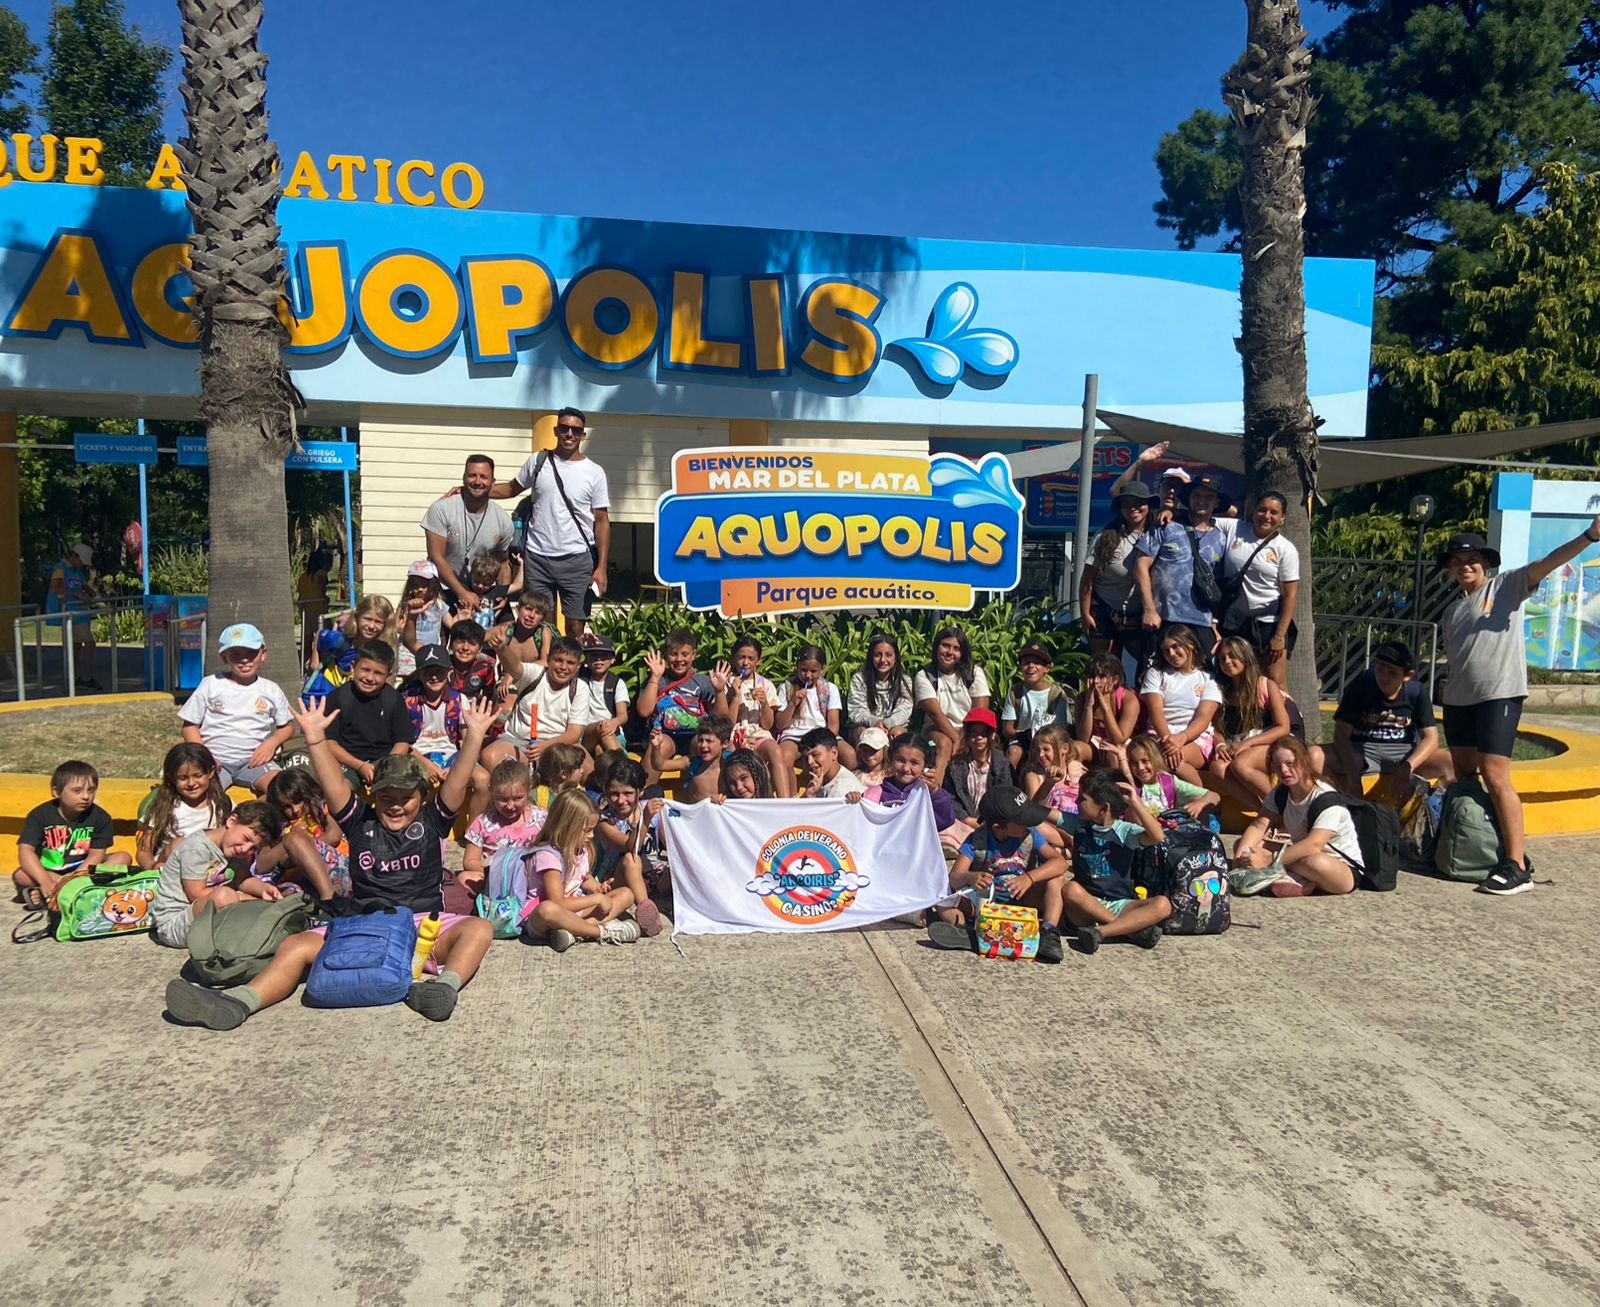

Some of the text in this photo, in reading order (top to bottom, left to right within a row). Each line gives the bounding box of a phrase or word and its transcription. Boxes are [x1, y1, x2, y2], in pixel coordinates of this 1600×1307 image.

[146, 143, 484, 209] AATICO
[80, 444, 107, 452] TICKETS
[116, 445, 153, 453] VOUCHERS
[292, 455, 343, 464] CON PULSERA
[688, 456, 813, 472] BIENVENIDOS
[708, 470, 921, 493] MAR DEL PLATA
[675, 510, 1007, 566] AQUOPOLIS
[757, 582, 838, 606] Parque
[761, 830, 848, 862] COLONIA DE VERANO
[380, 854, 420, 872] XBTO
